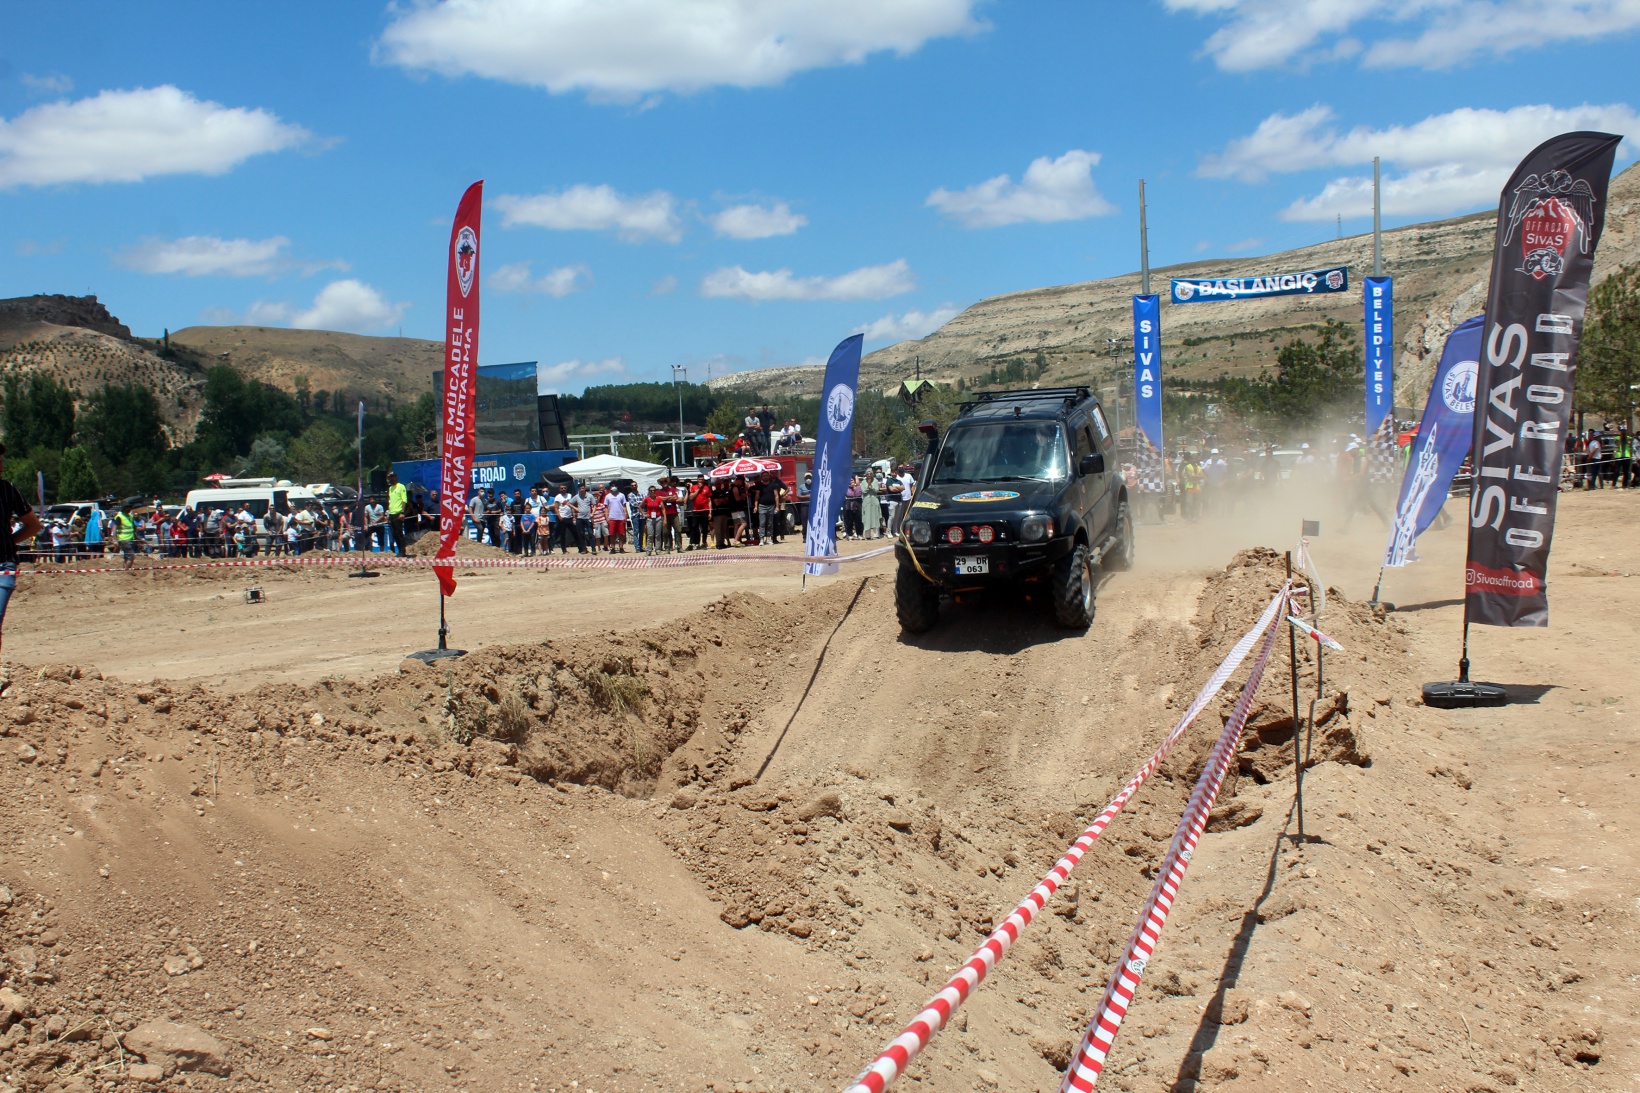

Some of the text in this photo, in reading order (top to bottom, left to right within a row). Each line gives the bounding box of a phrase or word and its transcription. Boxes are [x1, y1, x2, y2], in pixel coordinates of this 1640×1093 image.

[1199, 273, 1318, 298] BAŞLANGIÇ
[447, 307, 464, 426] MÜCADELE
[453, 328, 473, 448] KURTARMA
[1505, 313, 1574, 549] OFF ROAD
[480, 466, 507, 482] ROAD
[976, 557, 987, 565] DR
[1476, 572, 1534, 589] Sivasoffroad
